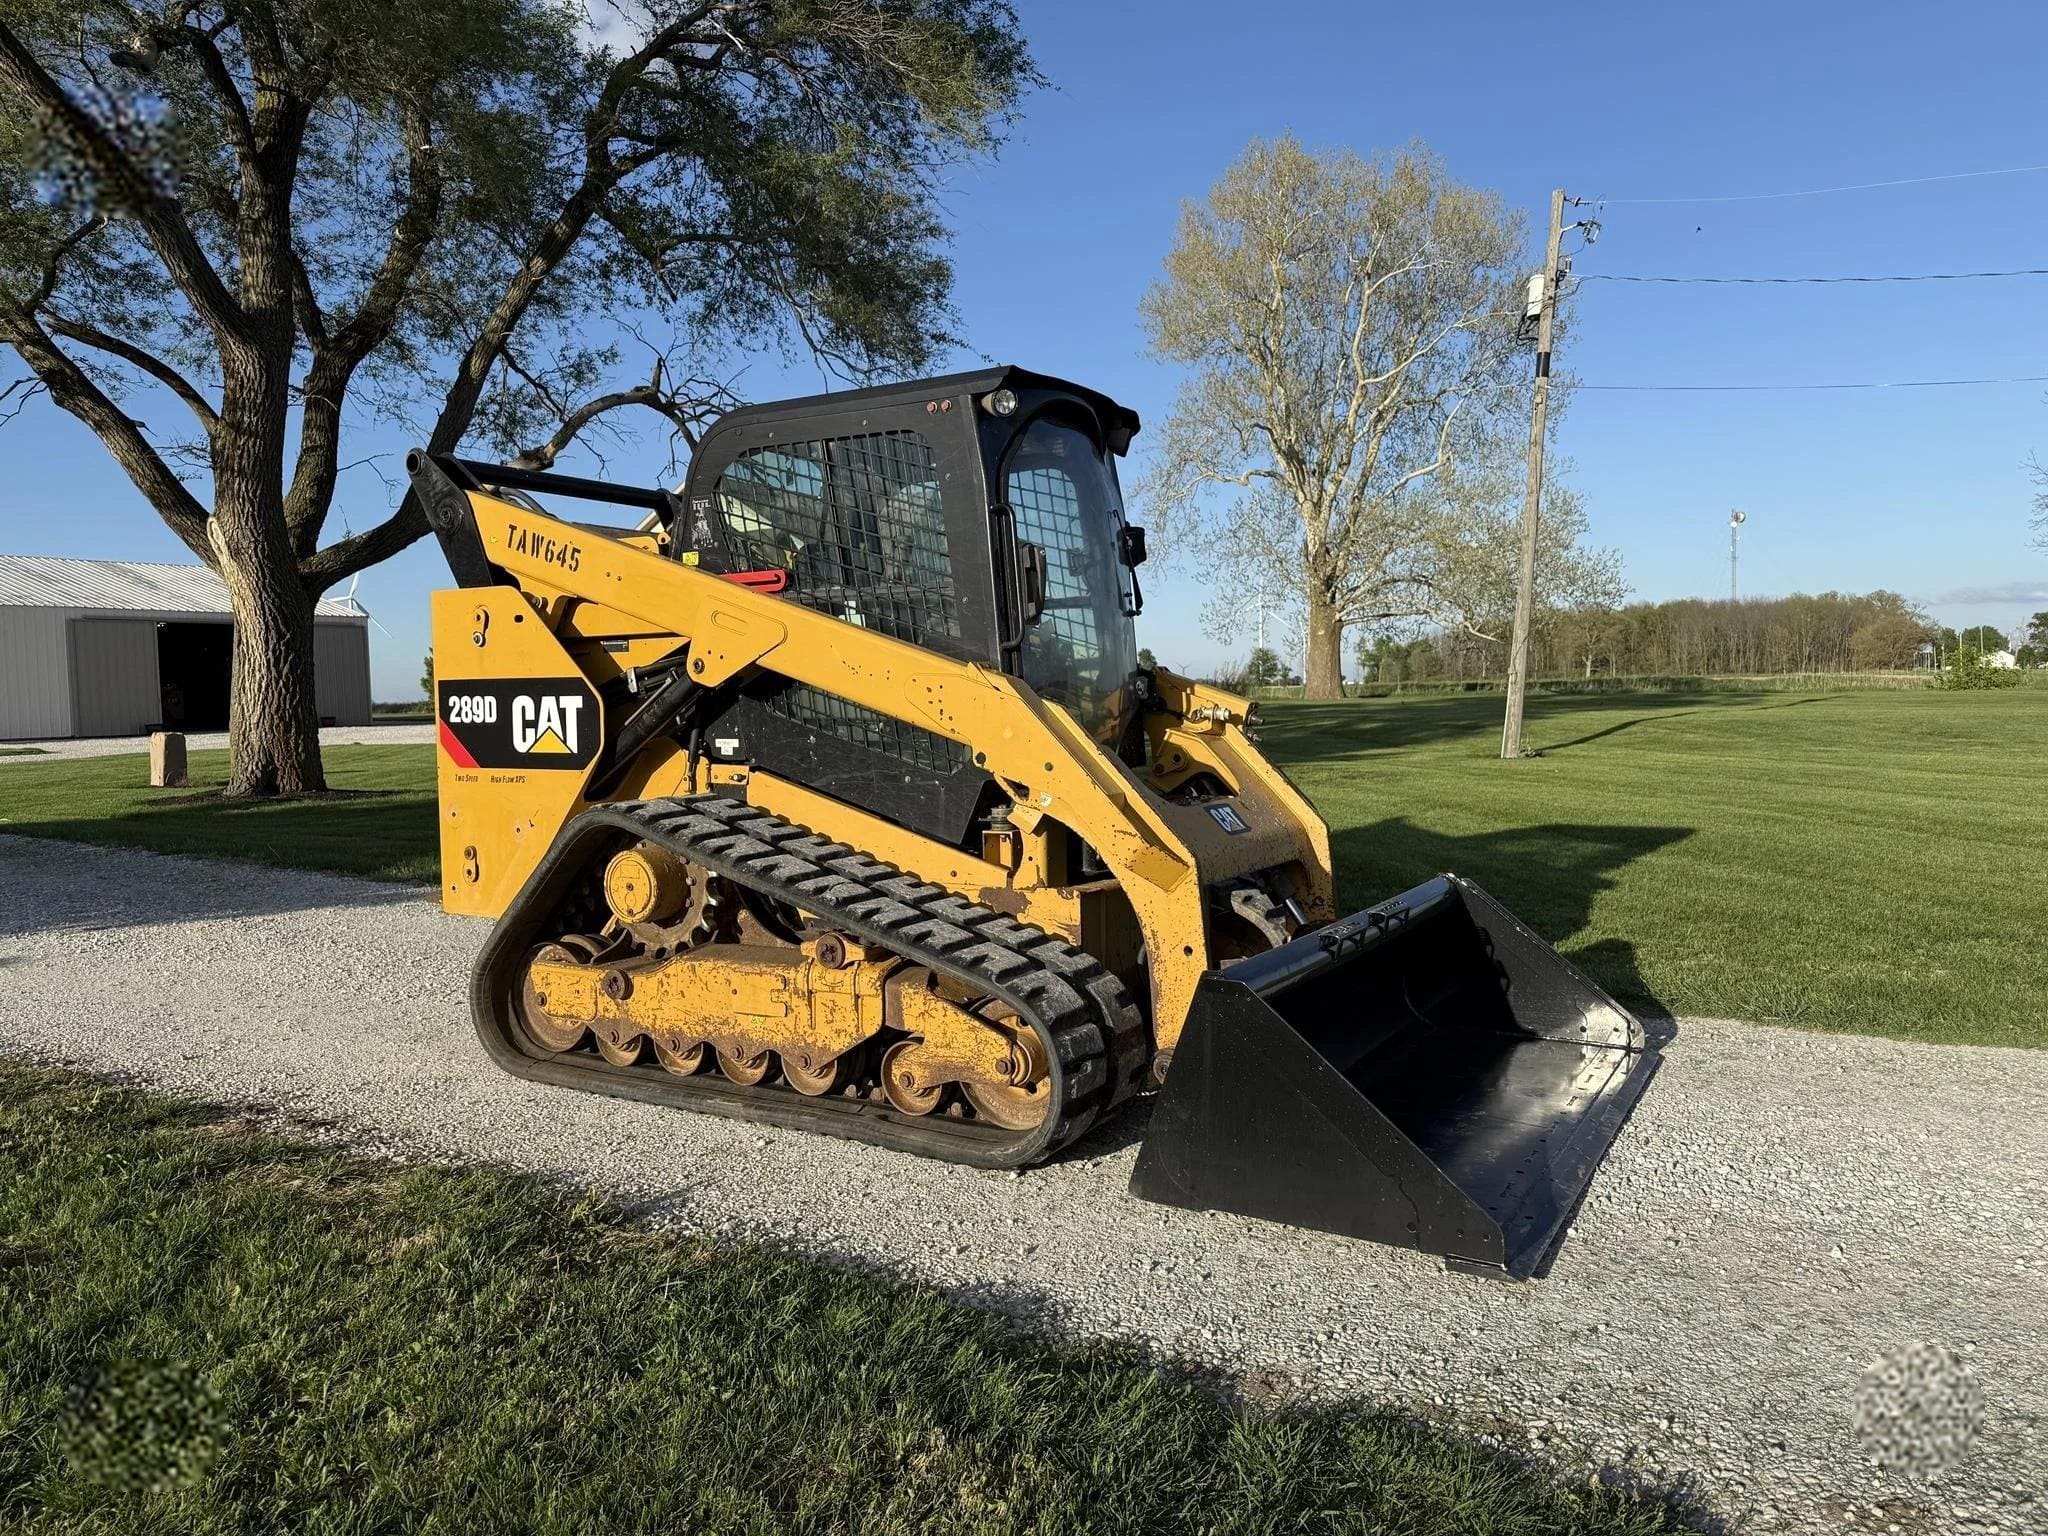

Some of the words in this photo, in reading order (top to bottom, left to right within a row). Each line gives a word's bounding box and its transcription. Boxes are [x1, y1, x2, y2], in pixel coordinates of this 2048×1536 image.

[507, 523, 582, 573] TAW645
[448, 695, 498, 724] 289D
[512, 694, 584, 754] CAT
[1209, 806, 1246, 832] CAT
